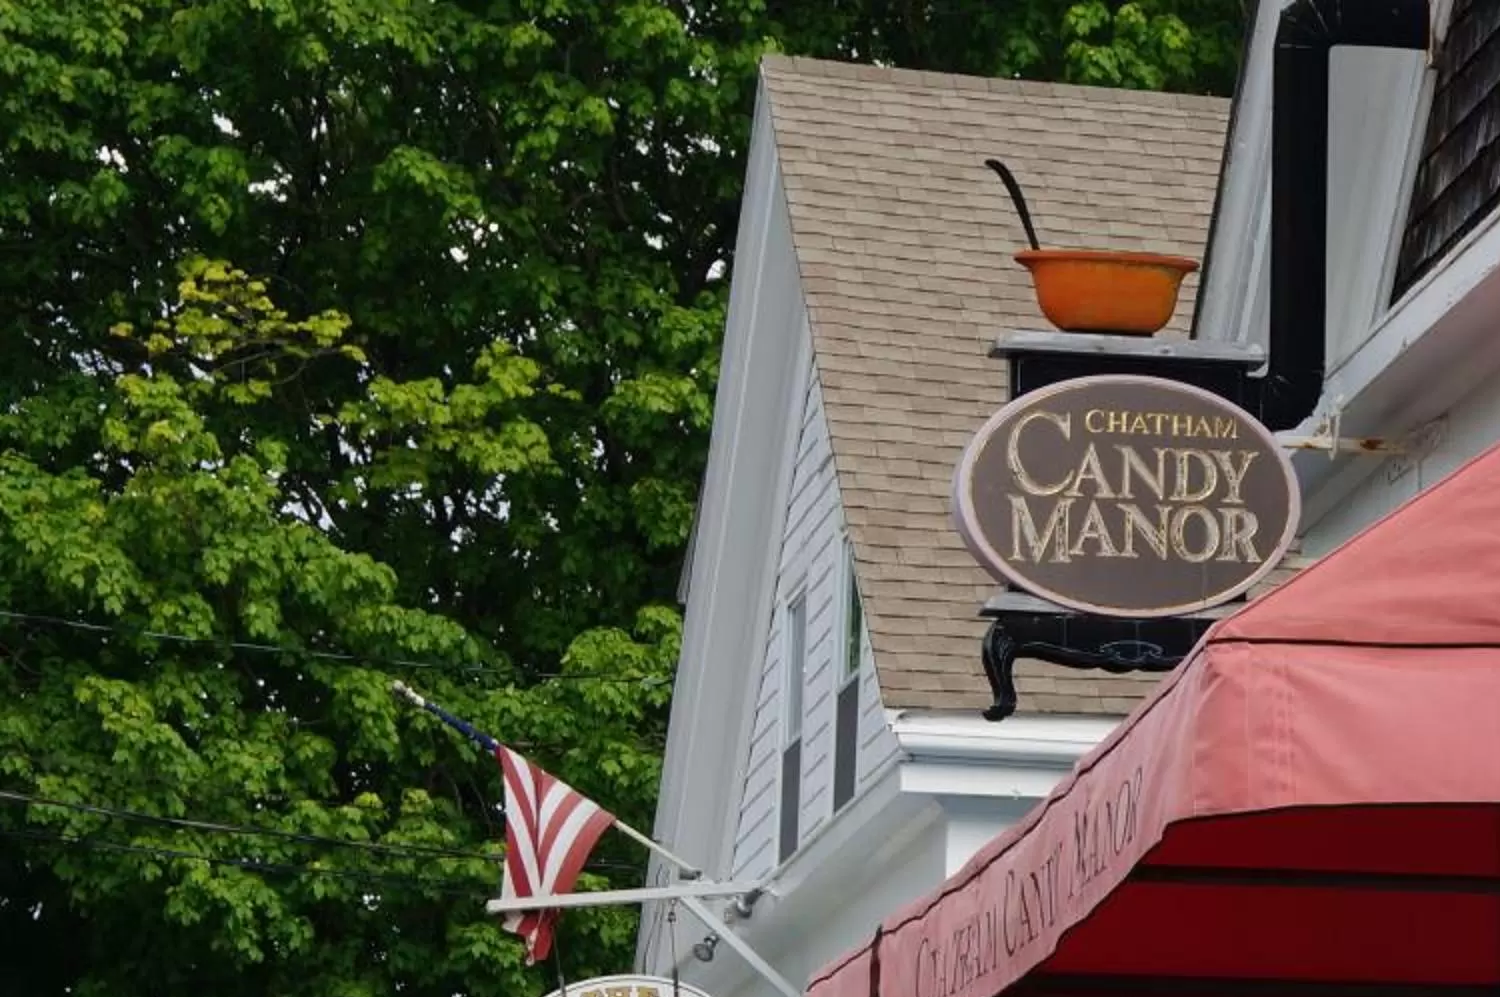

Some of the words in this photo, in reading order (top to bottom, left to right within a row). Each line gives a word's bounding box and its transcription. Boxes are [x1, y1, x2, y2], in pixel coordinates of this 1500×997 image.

[1007, 410, 1259, 505] CANDY
[1085, 409, 1239, 440] CHATHAM
[1007, 494, 1262, 565] MANOR
